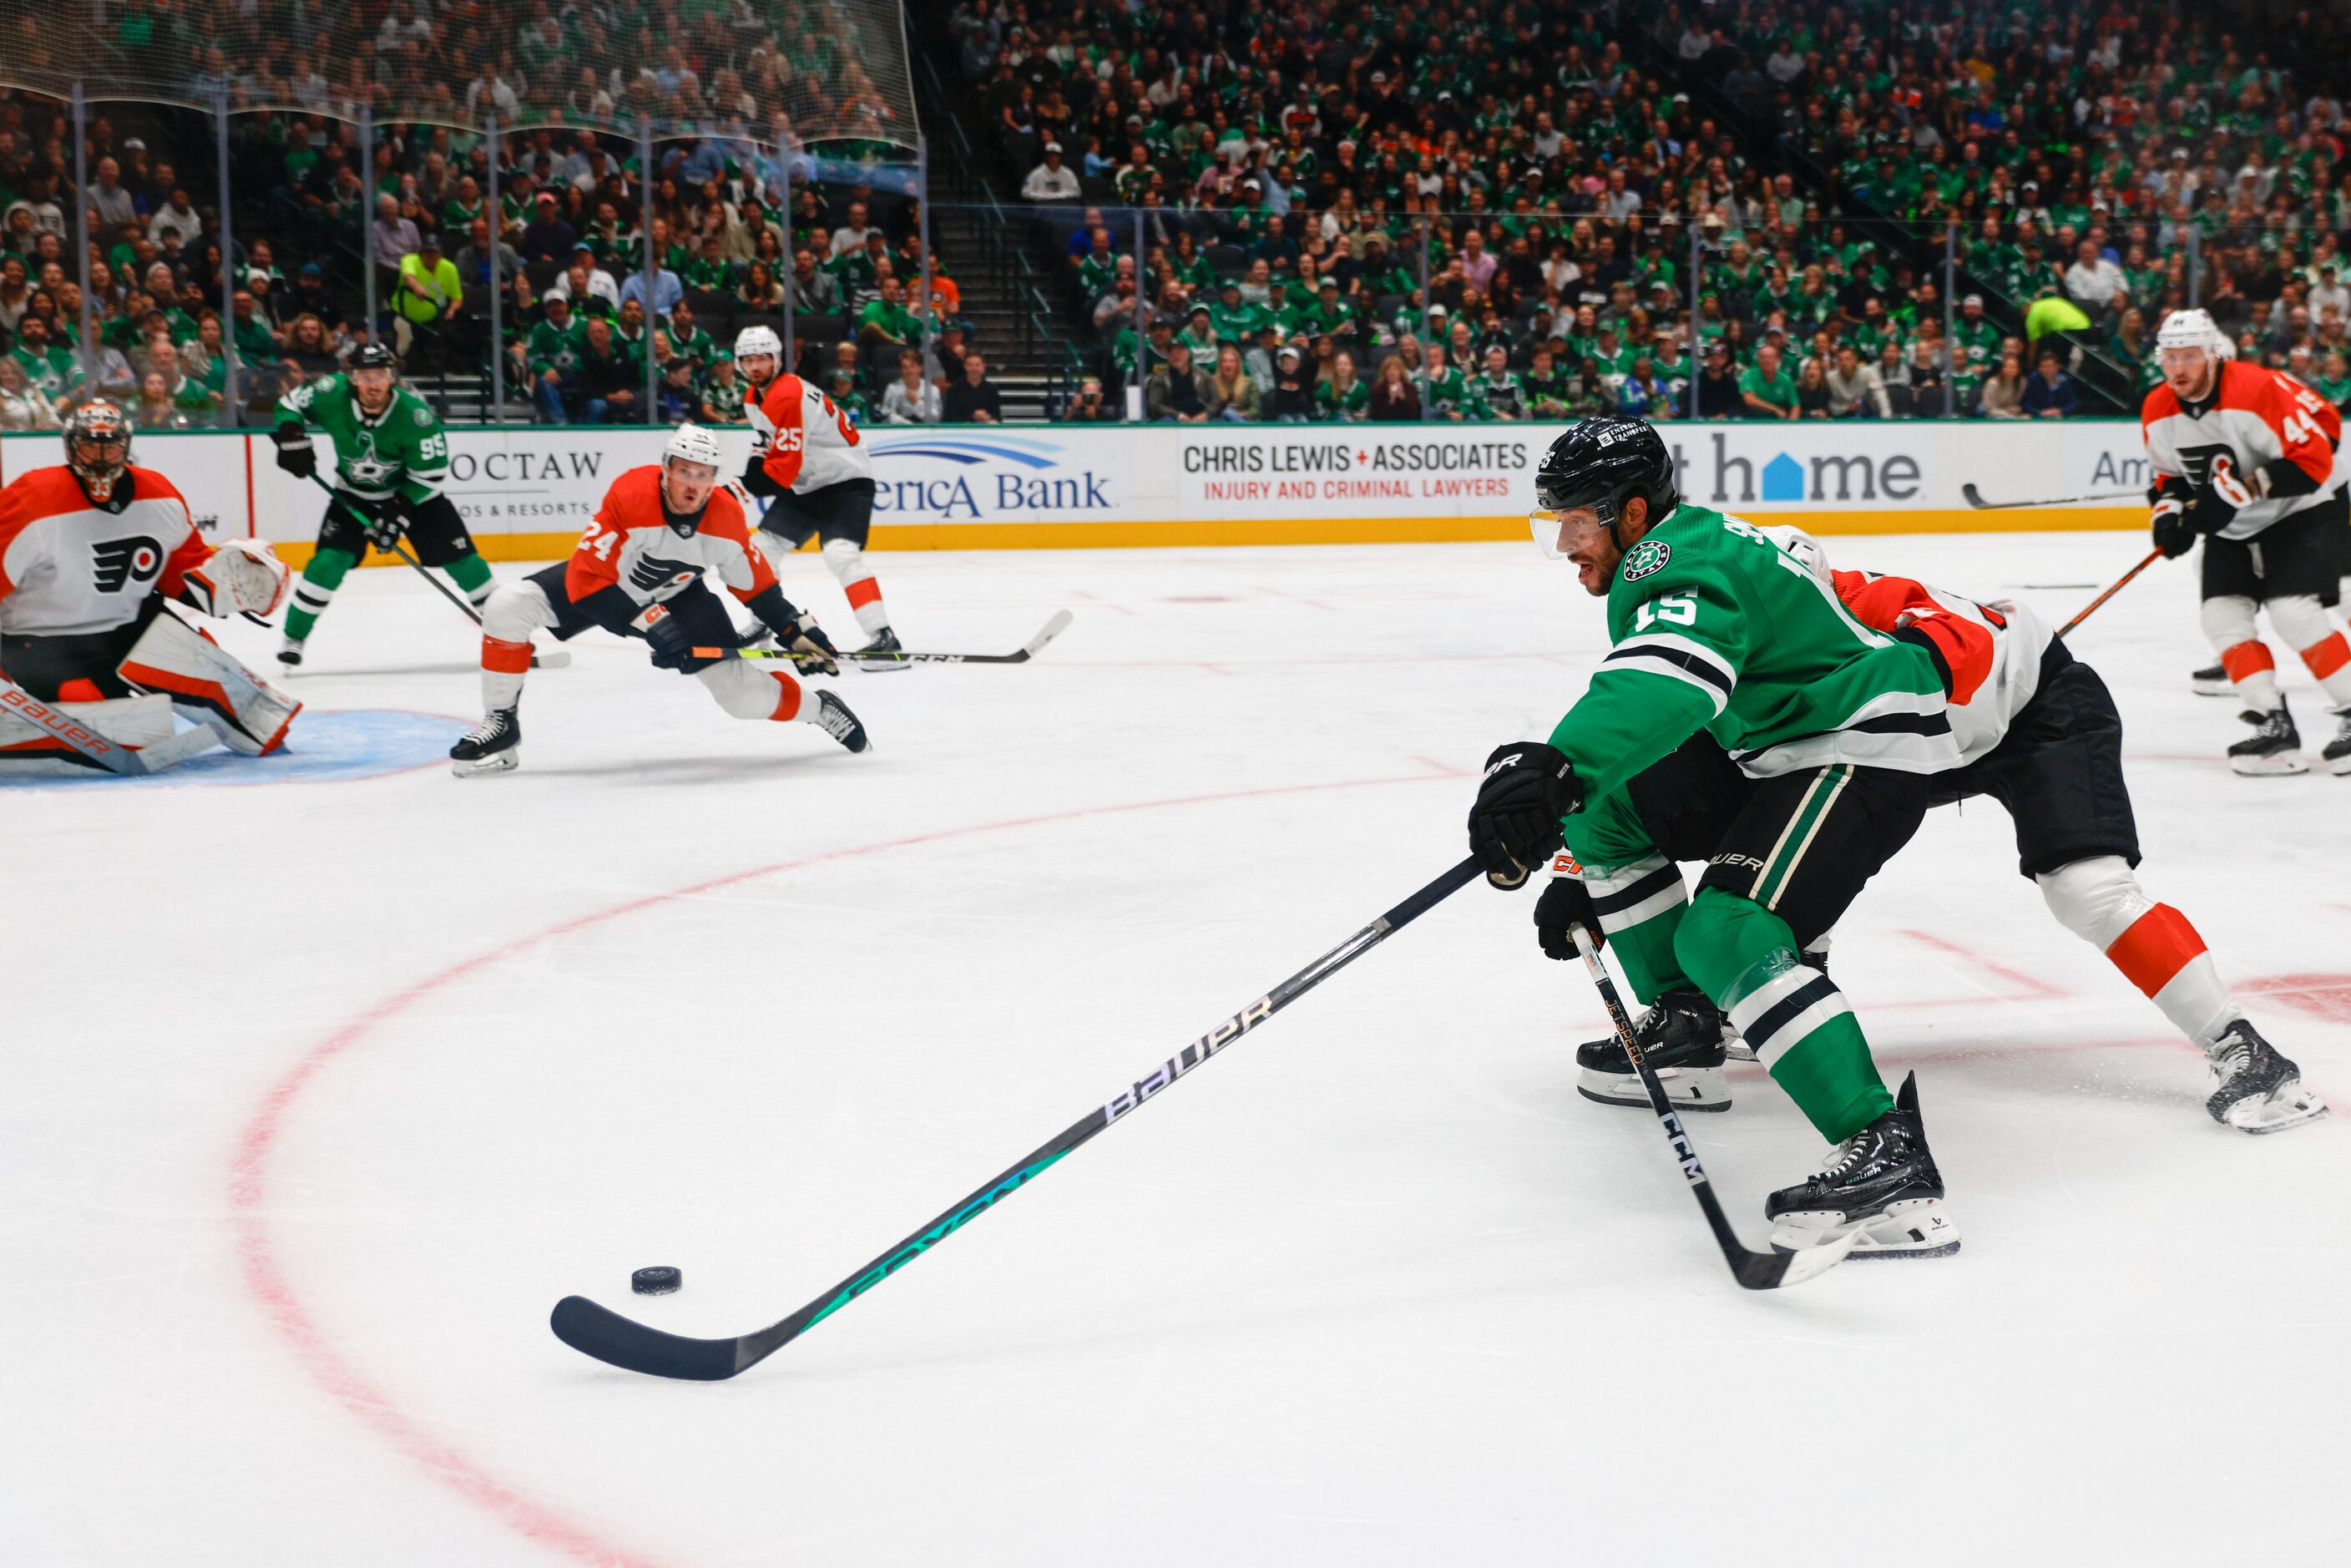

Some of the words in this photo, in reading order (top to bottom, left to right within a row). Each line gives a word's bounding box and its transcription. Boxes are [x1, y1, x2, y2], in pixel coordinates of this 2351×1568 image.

[776, 427, 801, 452] 25
[1610, 422, 1638, 435] ENERGY
[1613, 426, 1648, 443] TRANSFER
[419, 432, 447, 461] 95
[1184, 446, 1263, 473] CHRIS
[1272, 445, 1350, 472] LEWIS
[1373, 443, 1526, 471] ASSOCIATES
[451, 453, 604, 482] OCTAW
[1672, 443, 1690, 501] t
[2091, 451, 2152, 485] Am
[89, 476, 111, 497] 33
[873, 475, 983, 518] ericA
[995, 471, 1111, 510] Bank
[1205, 481, 1271, 500] INJURY
[1277, 481, 1316, 499] AND
[1323, 480, 1413, 498] CRIMINAL
[1423, 478, 1509, 498] LAWYERS
[460, 505, 482, 518] OS
[490, 504, 500, 517] &
[508, 503, 590, 517] RESORTS
[577, 521, 619, 561] 24
[1625, 542, 1664, 574] DALLAS
[1631, 552, 1667, 579] STARS
[1635, 584, 1699, 633] 15
[0, 690, 113, 756] BAUER
[1556, 762, 1570, 780] SMITH
[1708, 852, 1765, 872] UER
[1605, 999, 1645, 1065] JETSPEED
[1104, 994, 1273, 1127] BAUER
[1644, 1041, 1664, 1054] UER
[1658, 1111, 1708, 1186] CCM
[1845, 1166, 1882, 1185] BAUER
